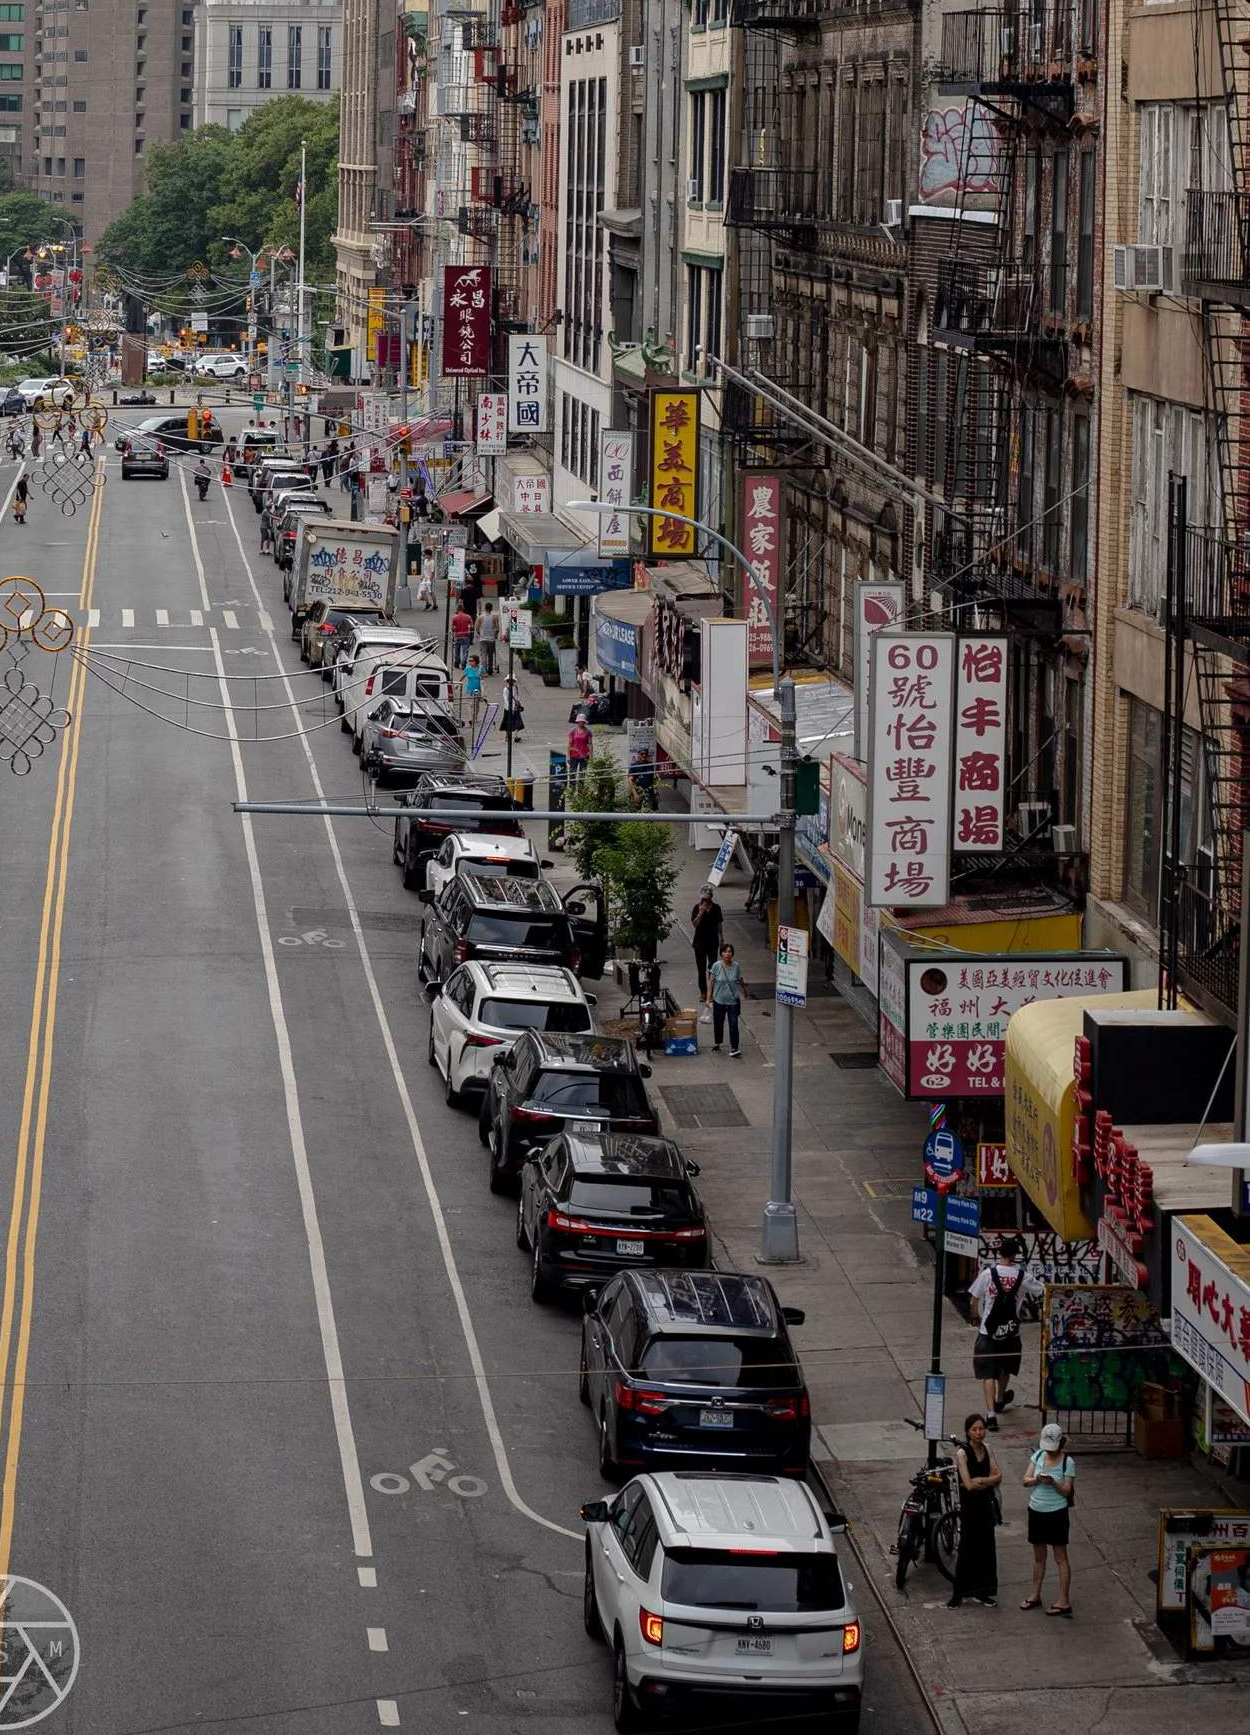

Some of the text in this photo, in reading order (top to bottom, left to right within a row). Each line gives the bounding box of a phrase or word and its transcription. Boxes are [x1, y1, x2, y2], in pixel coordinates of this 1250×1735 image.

[449, 289, 485, 308] 永昌
[458, 310, 475, 365] 眼鏡公司
[516, 341, 540, 426] 大帝國
[479, 396, 493, 441] 南少林
[604, 440, 630, 461] QQ
[657, 400, 692, 550] 華美商場
[516, 478, 546, 489] 大帝國
[606, 464, 624, 535] 西餅屋
[619, 625, 635, 646] LEASE
[967, 1076, 1000, 1088] TEL &
[933, 1171, 959, 1184] STANDING
[914, 1190, 928, 1204] M9
[947, 1196, 978, 1210] Battery Park City
[913, 1208, 933, 1222] M22
[947, 1213, 962, 1224] Battery
[962, 1216, 970, 1226] Park
[737, 1638, 771, 1651] KNV-4680
